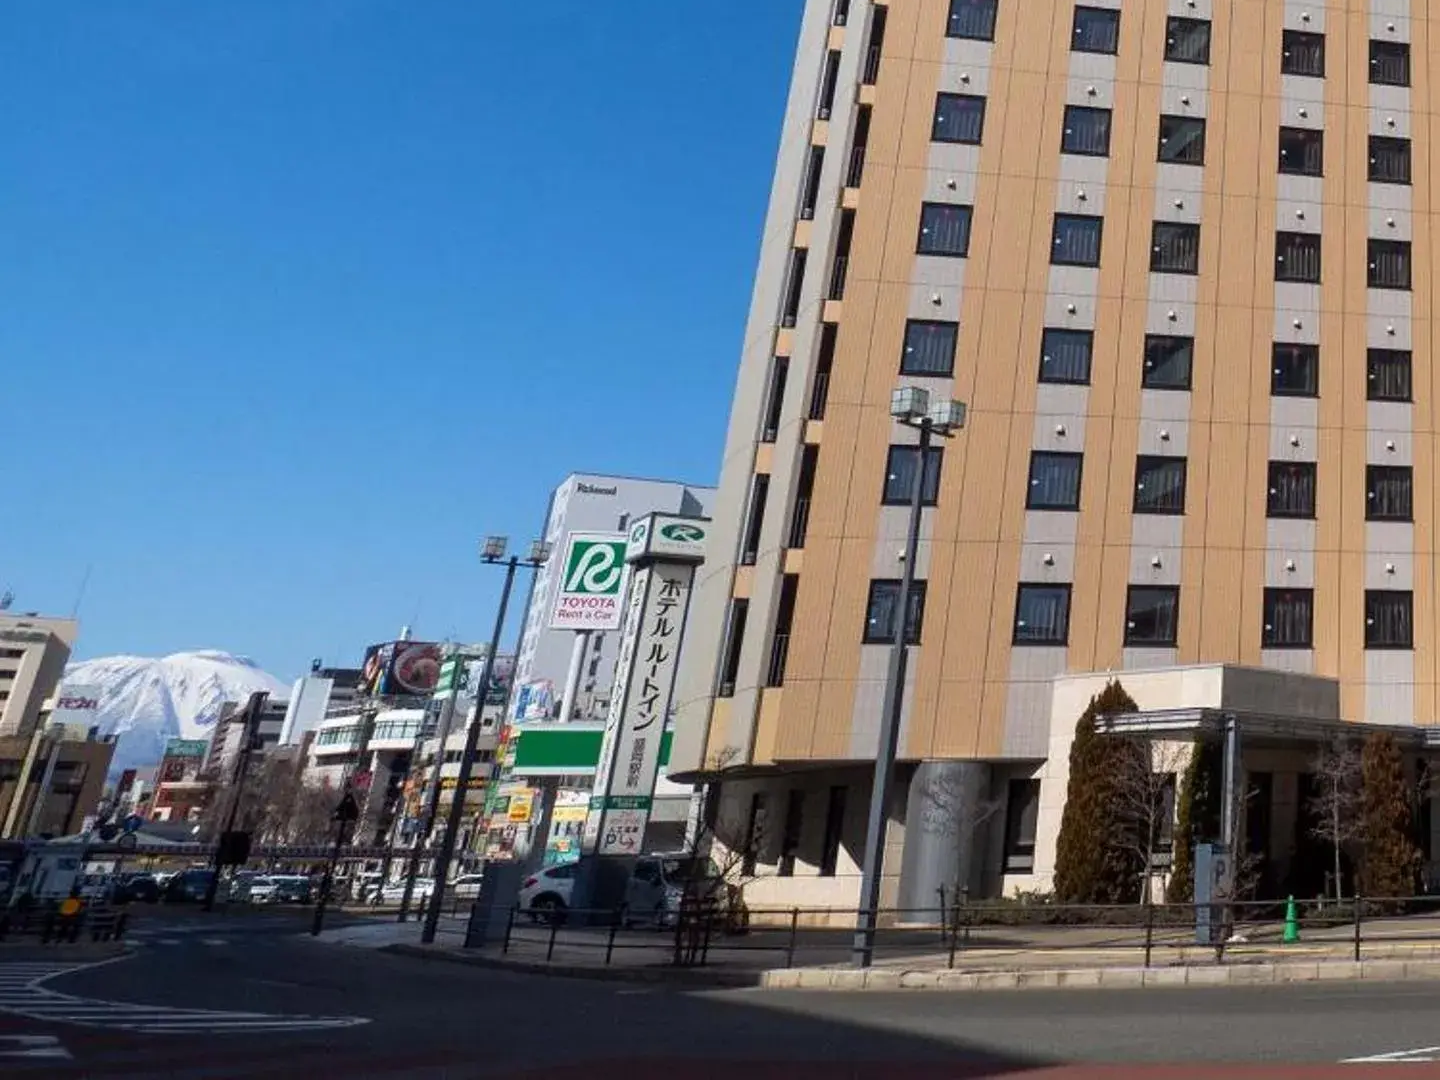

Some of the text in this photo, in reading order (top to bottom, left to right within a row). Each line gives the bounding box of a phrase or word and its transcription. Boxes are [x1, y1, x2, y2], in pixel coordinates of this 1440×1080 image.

[558, 609, 582, 619] Rent
[594, 608, 612, 620] Car
[561, 596, 616, 609] TOYOTA
[650, 578, 682, 638] ホテル
[632, 643, 669, 732] ルートイン
